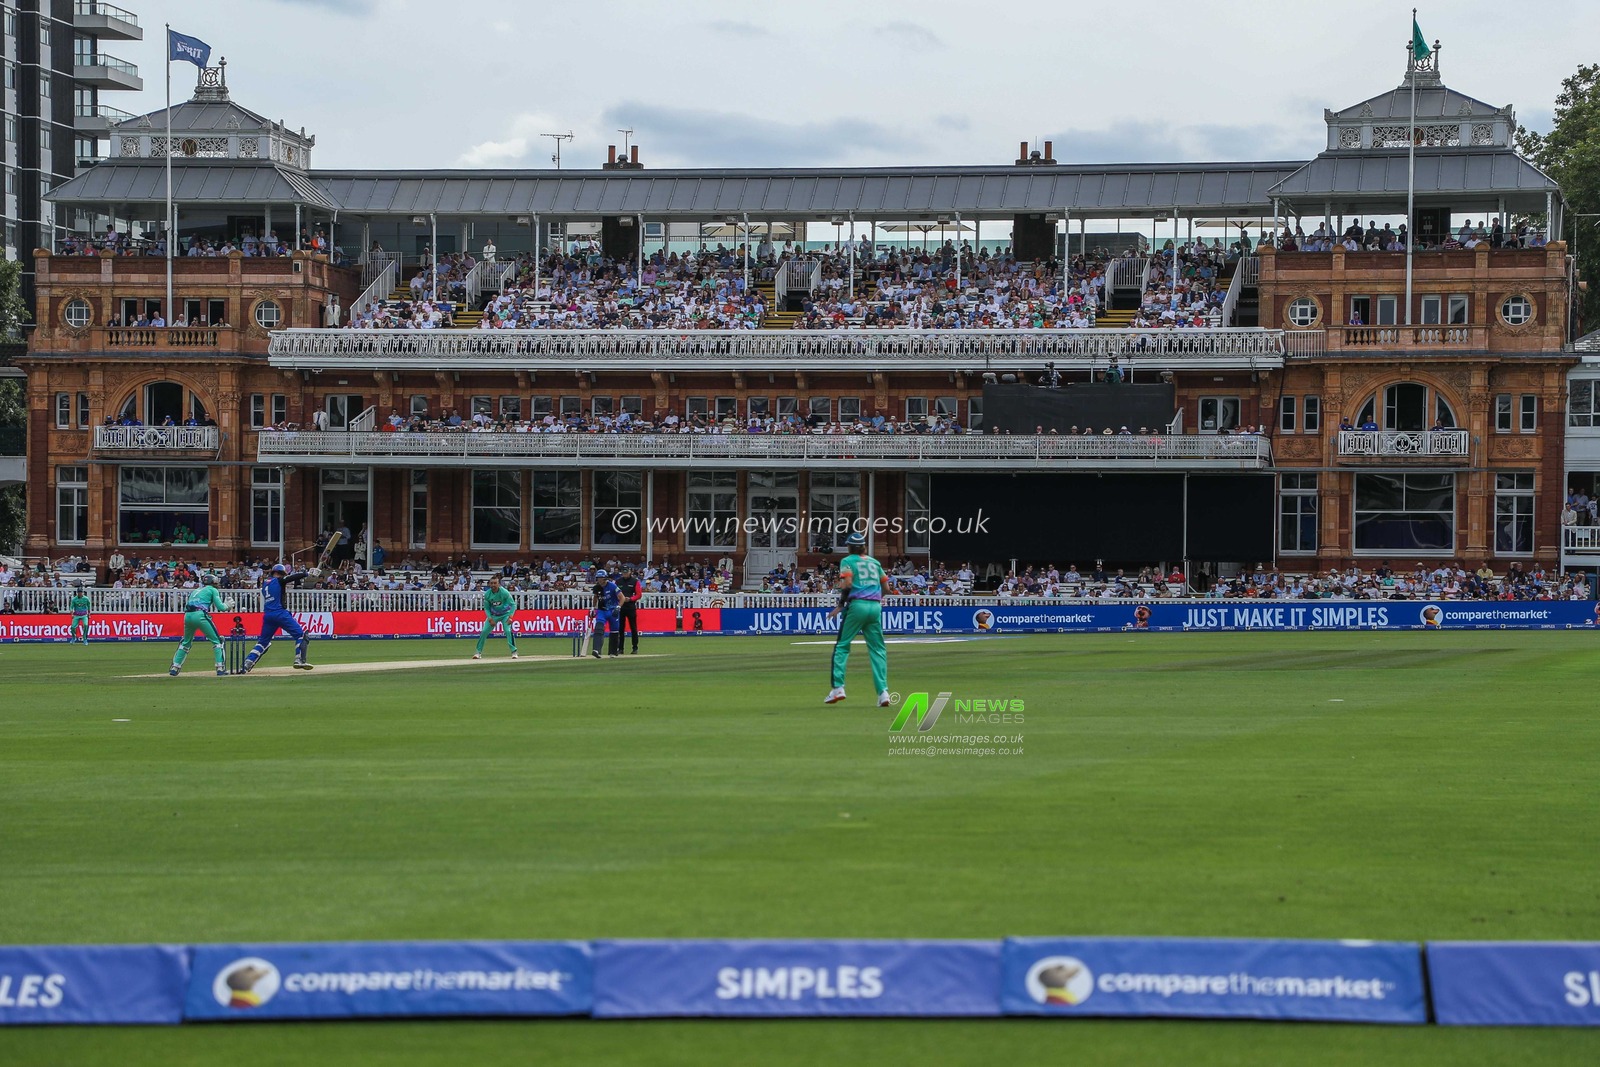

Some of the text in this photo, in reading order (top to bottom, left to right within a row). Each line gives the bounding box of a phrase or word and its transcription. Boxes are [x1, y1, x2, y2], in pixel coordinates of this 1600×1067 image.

[427, 616, 452, 632] Life
[523, 616, 554, 632] with
[750, 612, 792, 631] JUST
[1182, 607, 1388, 627] JUST MAKE IT SIMPLES
[112, 620, 163, 636] Vitality
[715, 965, 884, 1000] SIMPLES
